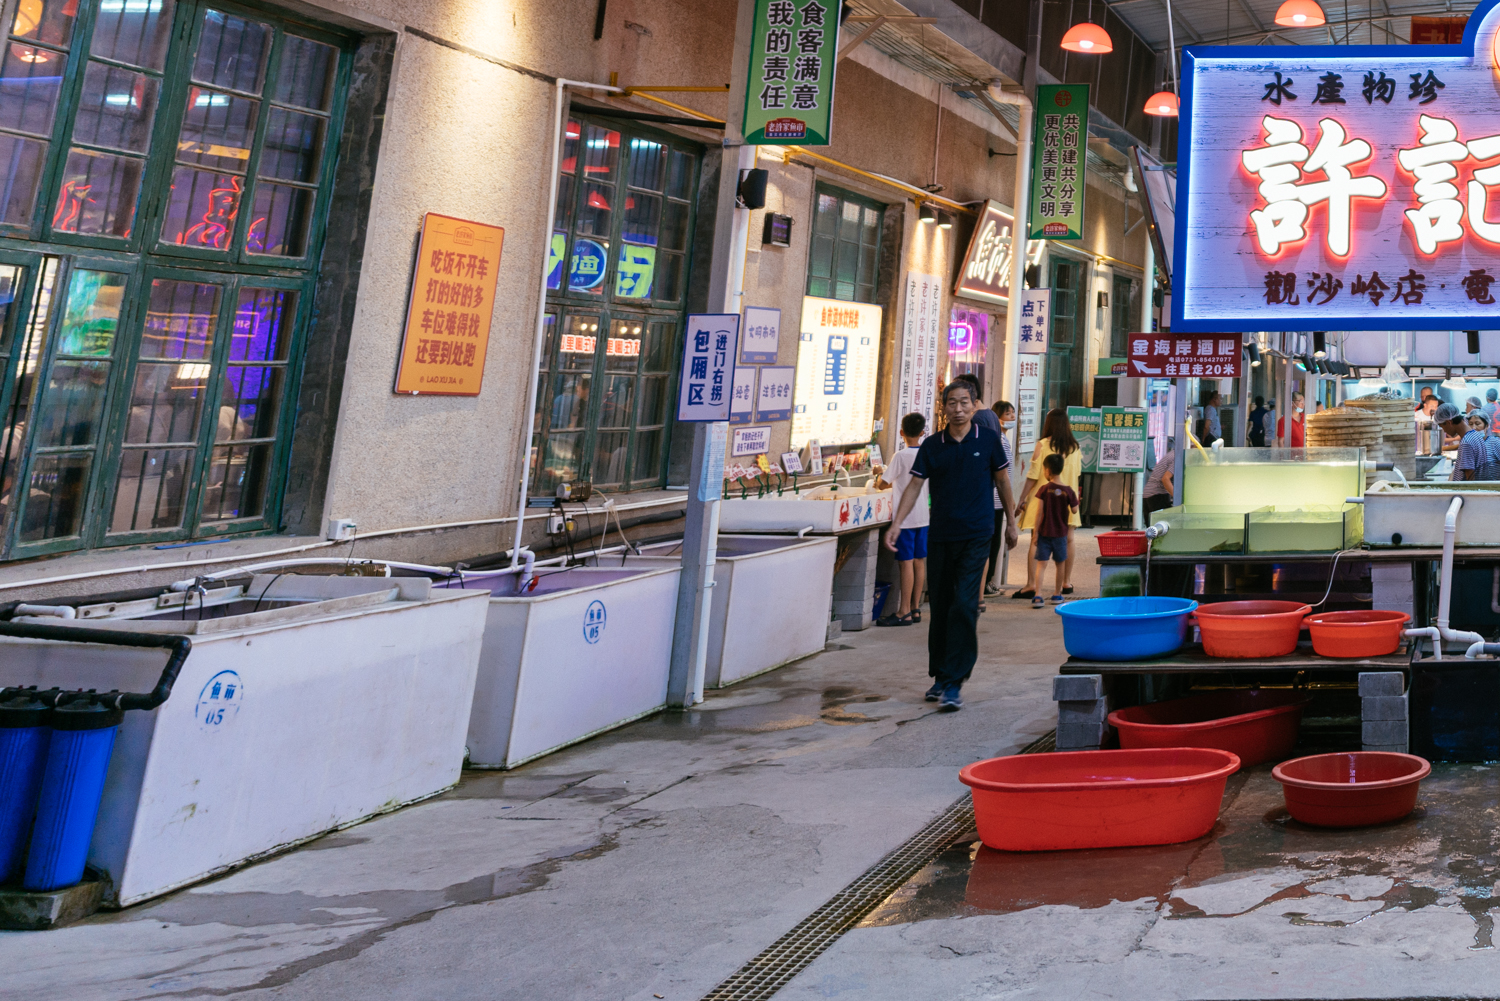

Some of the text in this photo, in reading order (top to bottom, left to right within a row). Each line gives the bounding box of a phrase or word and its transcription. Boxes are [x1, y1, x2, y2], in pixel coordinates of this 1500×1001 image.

[1261, 70, 1447, 106] 水產物珍
[1040, 113, 1061, 218] 更优美更文明
[1058, 113, 1081, 219] 共创建共分享
[431, 249, 489, 281] 吃饭不开车
[426, 277, 484, 309] 打的好的多
[420, 308, 481, 339] 车位难得找
[1021, 300, 1034, 342] 点菜
[1035, 300, 1046, 342] 下单处
[415, 338, 477, 368] 还要到处跑
[913, 281, 928, 413] 老许家鱼市主题
[1132, 339, 1235, 356] 金海岸酒吧
[687, 329, 710, 406] 包厢区
[708, 329, 731, 407] (进门右拐)
[1165, 364, 1235, 376] 往里走20米
[1104, 413, 1144, 427] 温馨提示
[589, 626, 599, 638] 05
[205, 708, 225, 725] 05
